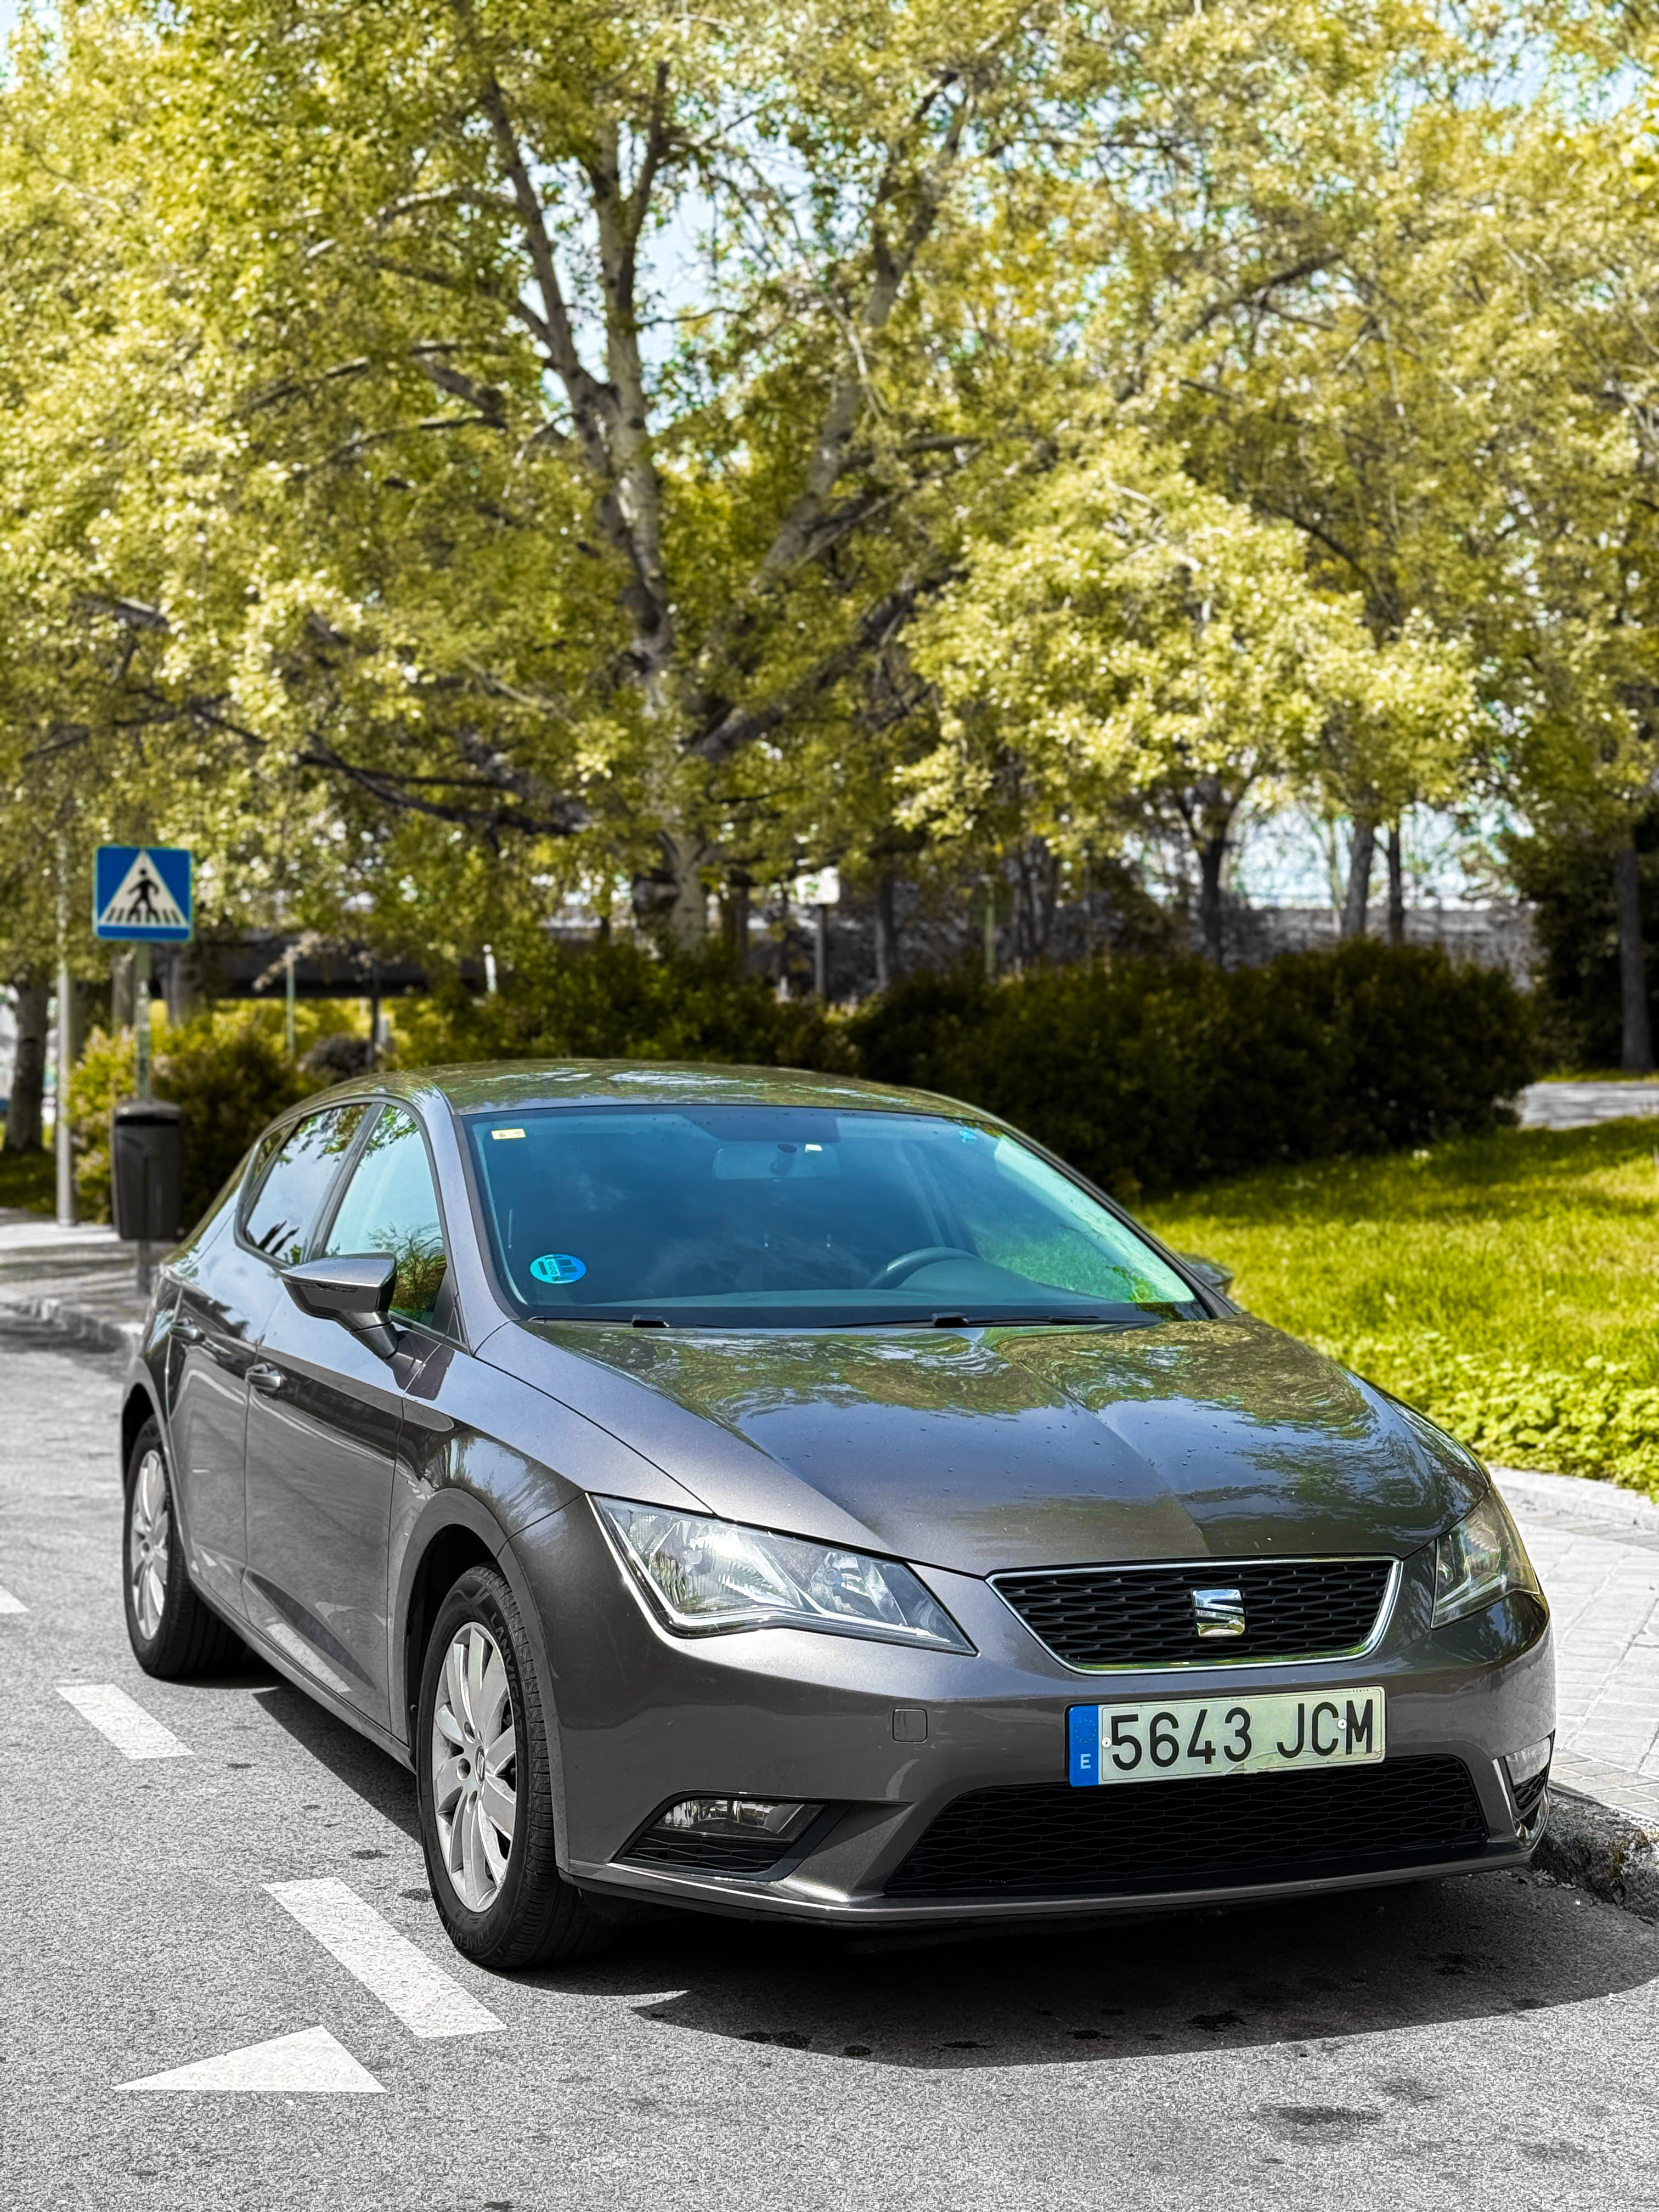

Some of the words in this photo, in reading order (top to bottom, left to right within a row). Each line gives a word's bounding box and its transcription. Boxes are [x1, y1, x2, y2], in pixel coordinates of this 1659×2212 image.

[1111, 1707, 1252, 1770] 5643
[1277, 1699, 1373, 1758] JCM
[1080, 1753, 1091, 1769] E
